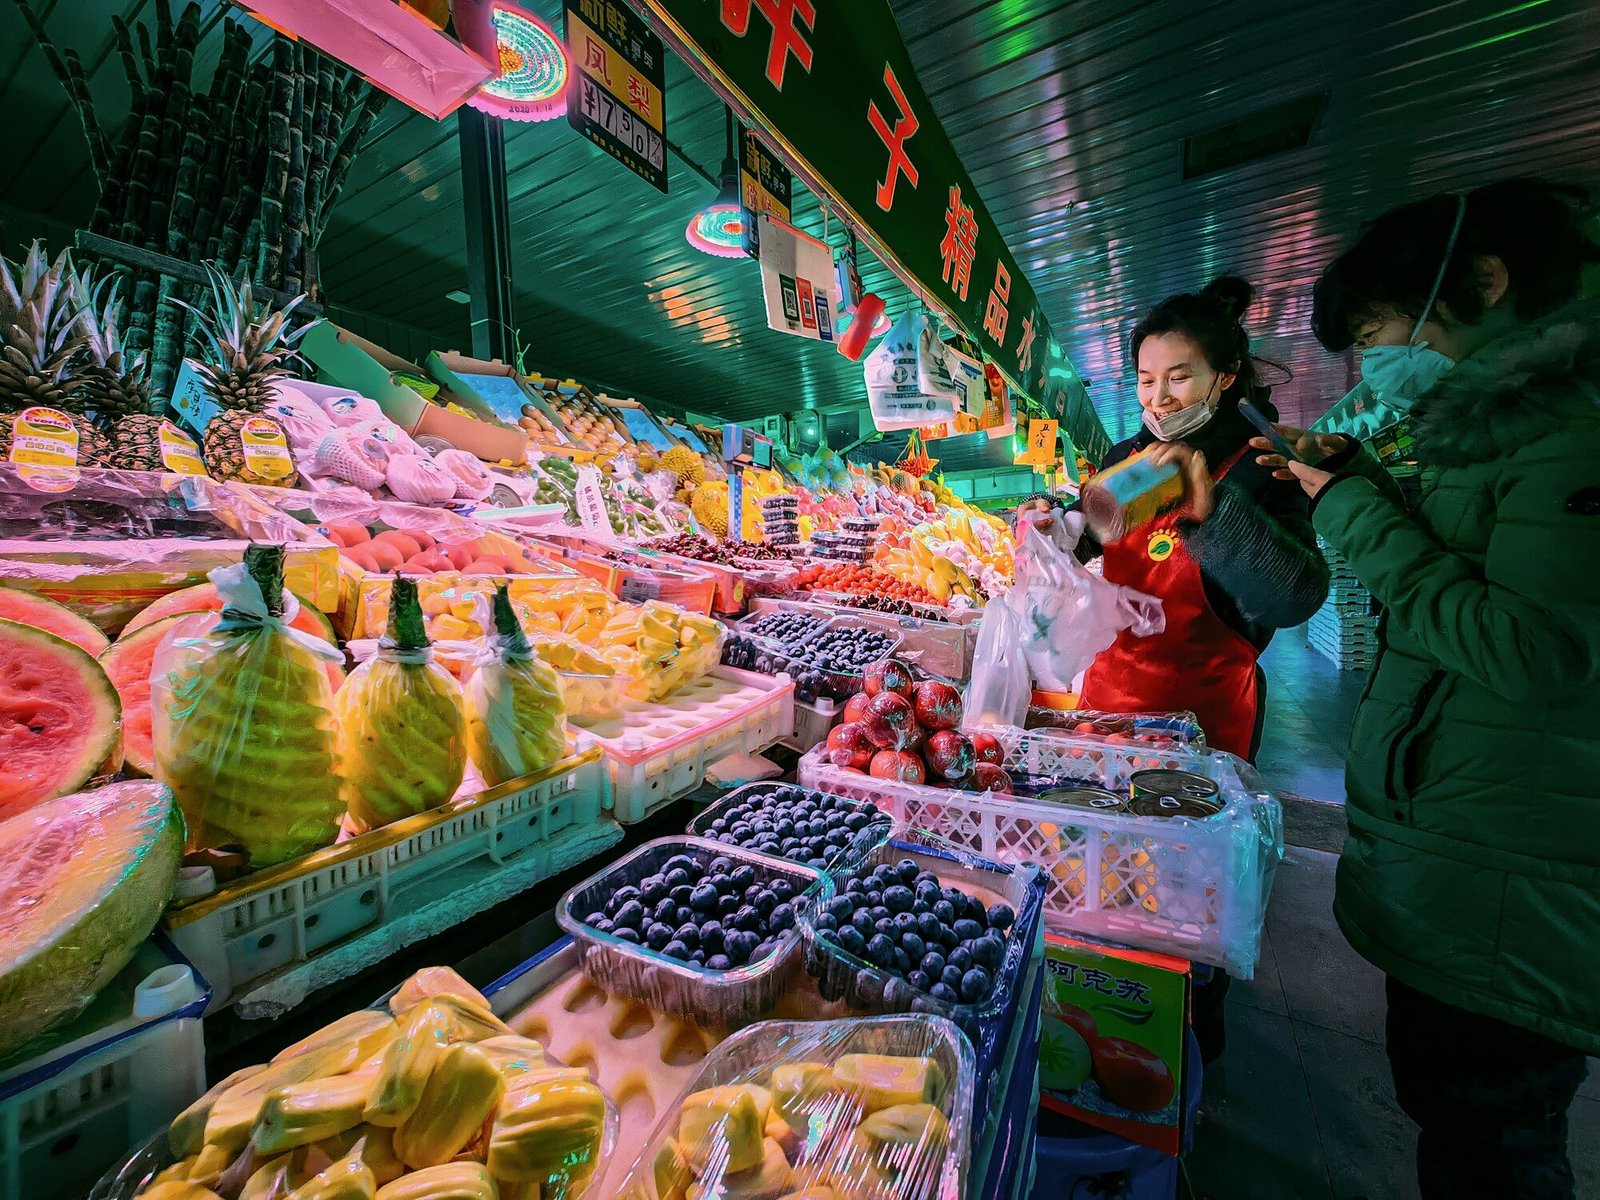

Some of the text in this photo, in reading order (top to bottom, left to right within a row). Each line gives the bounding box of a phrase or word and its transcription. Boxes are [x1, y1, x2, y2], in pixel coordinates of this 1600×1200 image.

[585, 34, 652, 119] 凤梨
[24, 415, 72, 430] Everich
[1045, 958, 1152, 1005] 阿克苏
